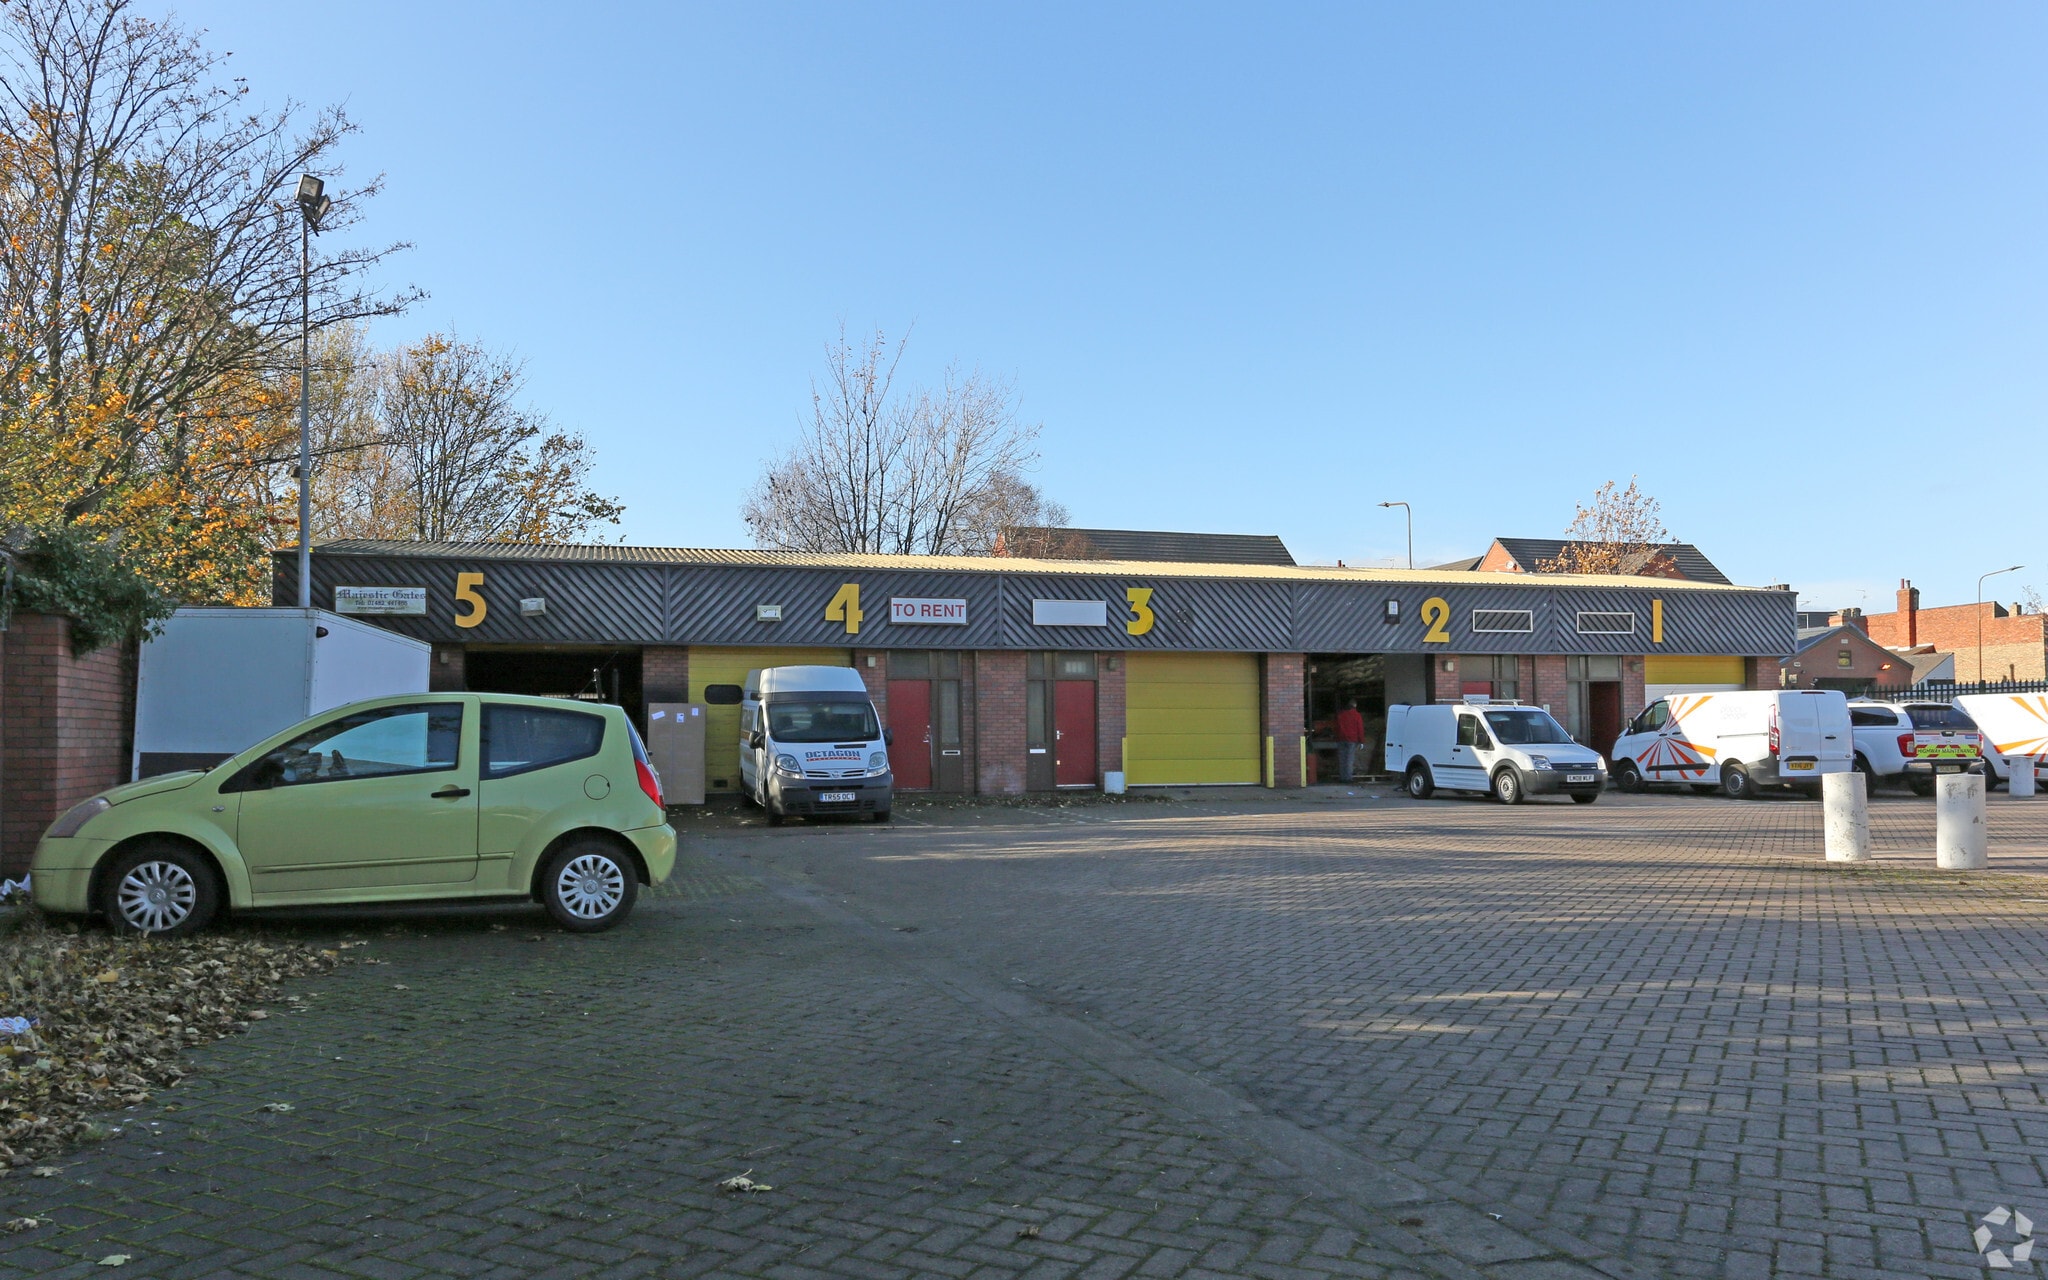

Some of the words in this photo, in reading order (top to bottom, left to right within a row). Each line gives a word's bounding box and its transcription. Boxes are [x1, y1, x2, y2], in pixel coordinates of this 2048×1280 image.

[337, 589, 388, 600] Majestic
[392, 589, 426, 599] Gates
[455, 572, 487, 628] 5
[825, 584, 863, 634] 4
[893, 604, 915, 617] TO
[921, 604, 964, 617] RENT
[1127, 588, 1154, 635] 3
[1421, 597, 1450, 643] 2
[1652, 599, 1663, 643] 1
[824, 793, 840, 801] TR55
